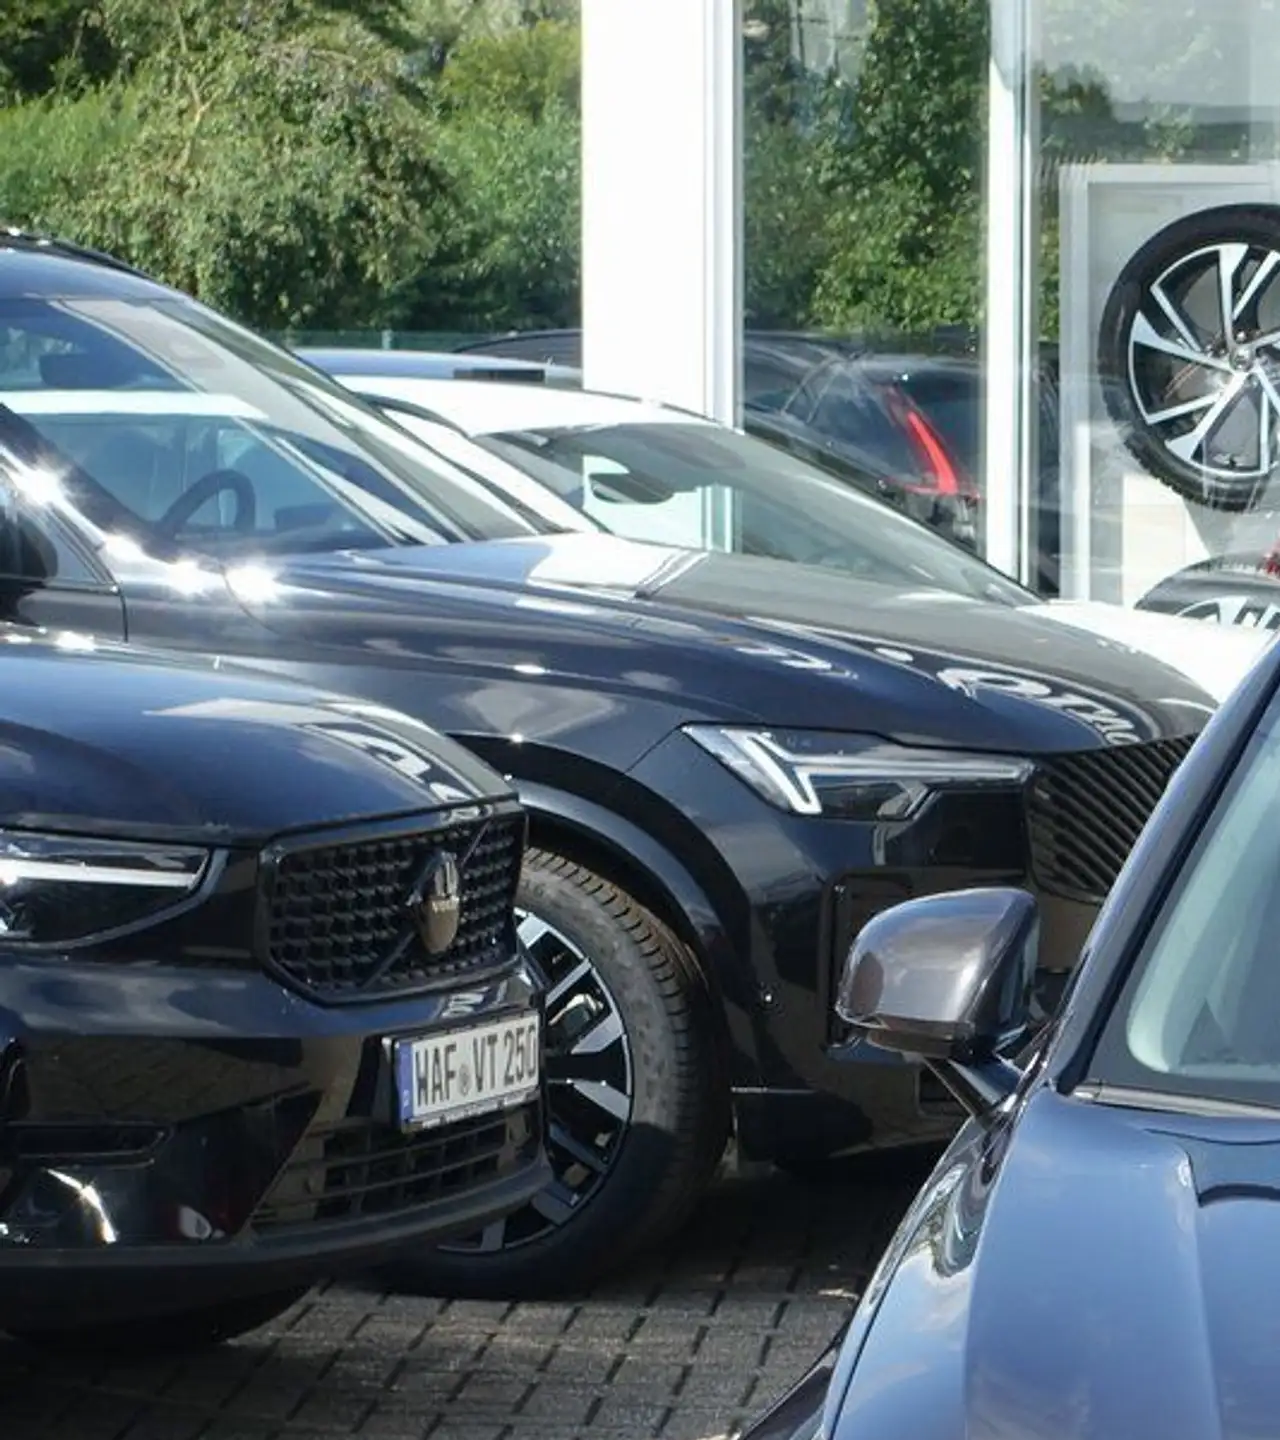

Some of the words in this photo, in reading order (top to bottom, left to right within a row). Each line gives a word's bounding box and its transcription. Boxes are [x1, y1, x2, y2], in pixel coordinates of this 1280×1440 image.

[415, 1044, 457, 1107] WAF
[472, 1034, 498, 1093] VT
[504, 1023, 536, 1087] 250
